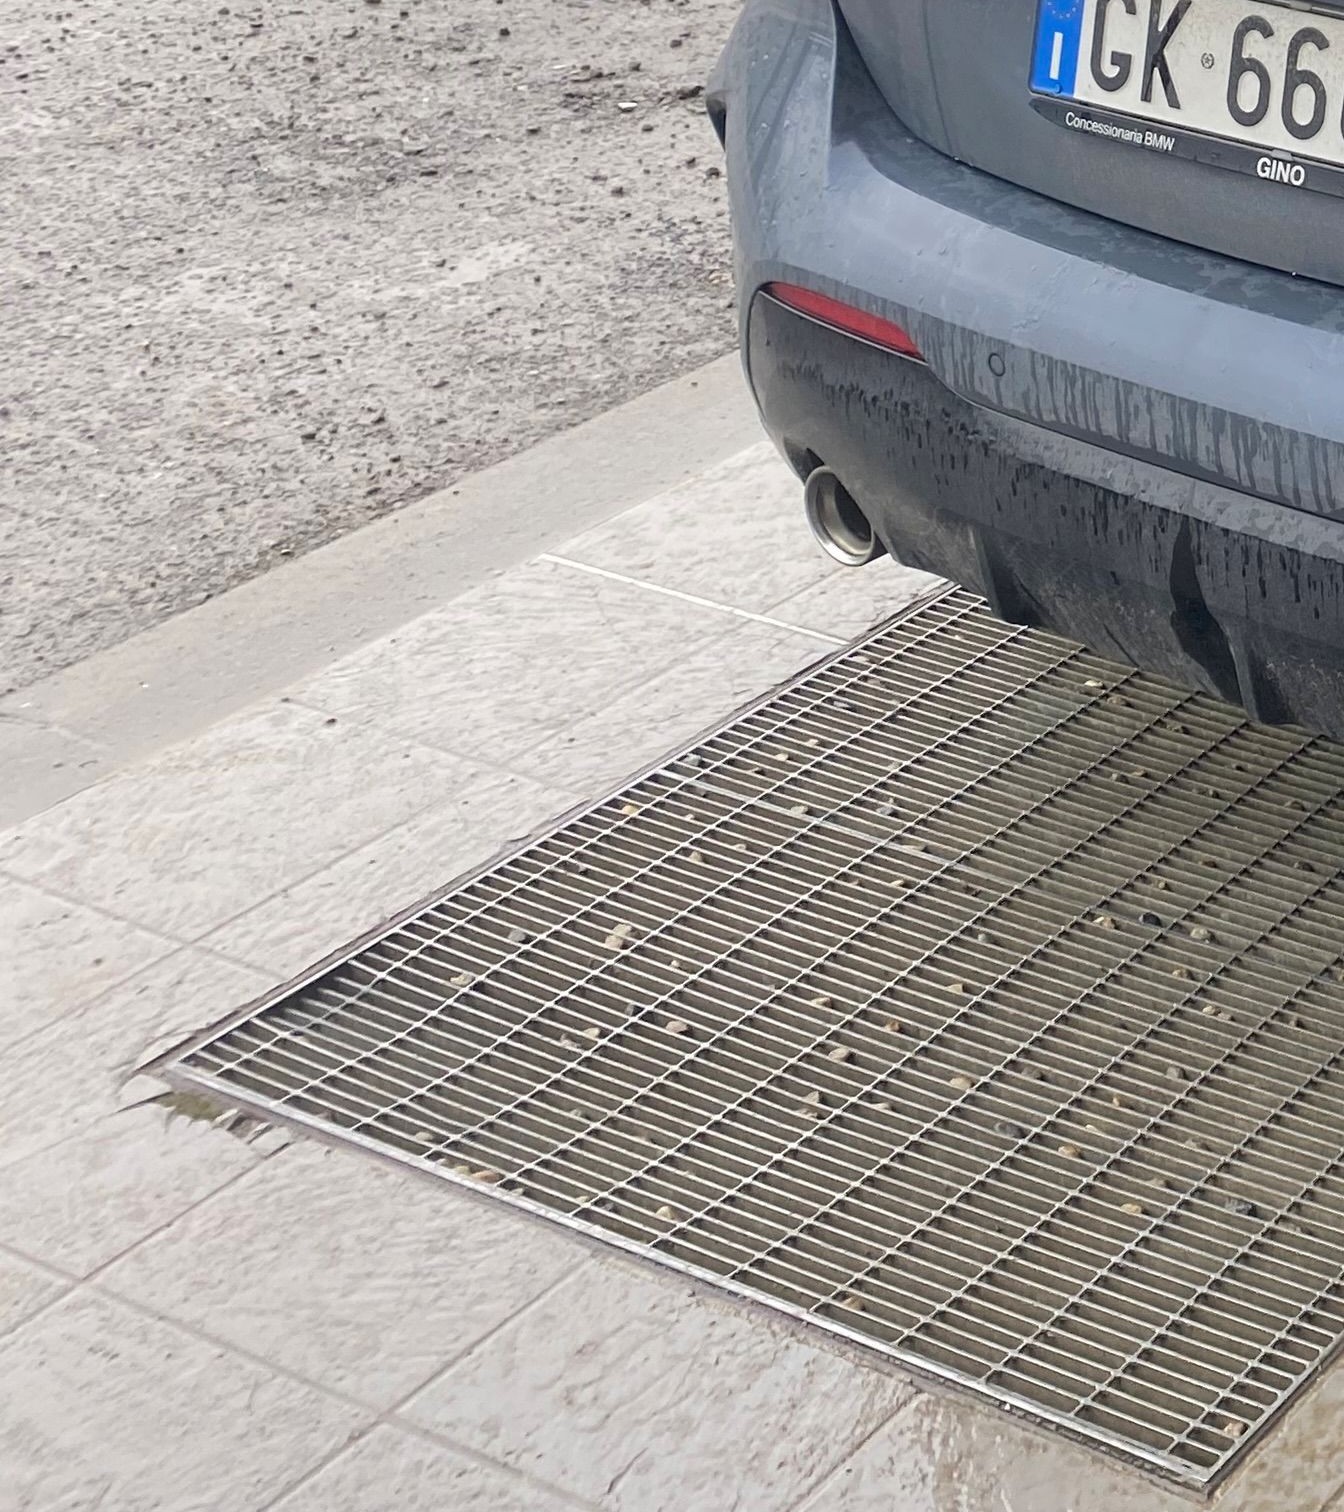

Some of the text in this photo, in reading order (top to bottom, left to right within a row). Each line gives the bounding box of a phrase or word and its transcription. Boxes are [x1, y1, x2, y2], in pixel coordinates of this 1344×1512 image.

[1065, 111, 1176, 152] Concessionaria BMW
[1256, 157, 1306, 187] GINO
